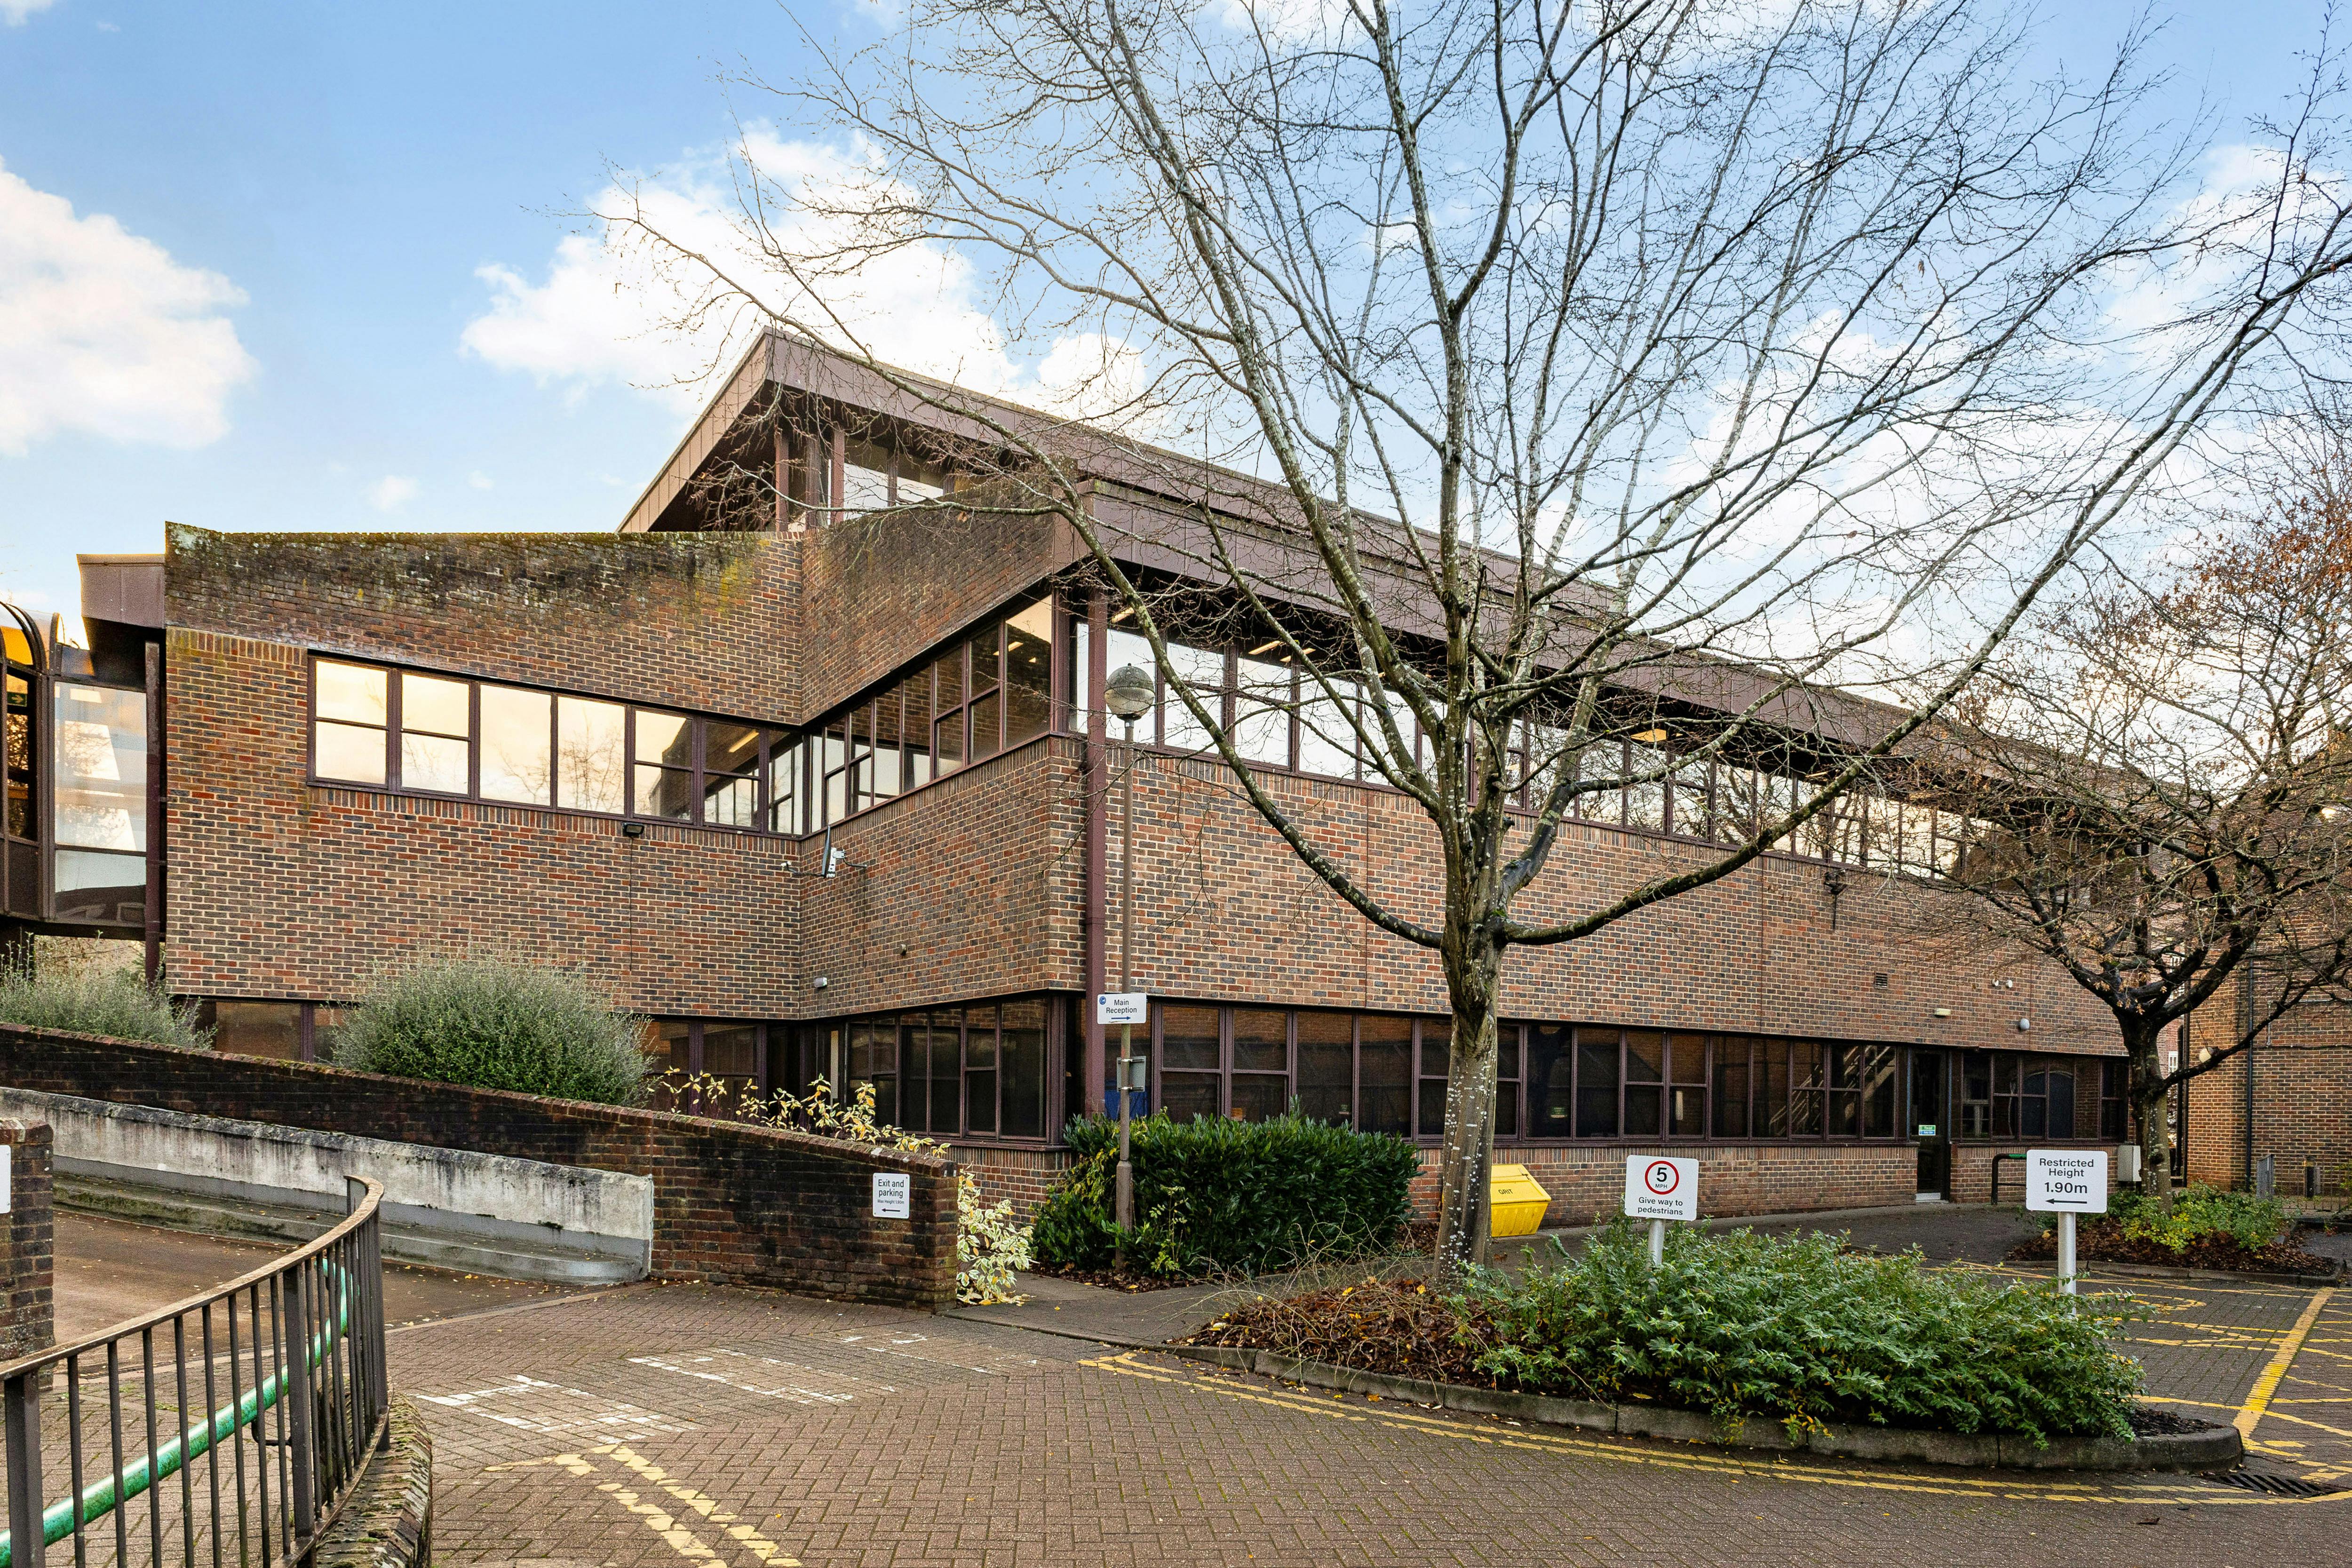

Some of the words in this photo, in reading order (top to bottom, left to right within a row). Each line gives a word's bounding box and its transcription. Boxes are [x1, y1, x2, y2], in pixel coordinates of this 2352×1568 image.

[2040, 1158, 2094, 1167] Restricted
[1656, 1167, 1667, 1182] 5
[2049, 1168, 2084, 1178] Height
[2044, 1182, 2088, 1194] 1.90m
[879, 1188, 903, 1199] parking
[1638, 1206, 1683, 1215] pedestrians
